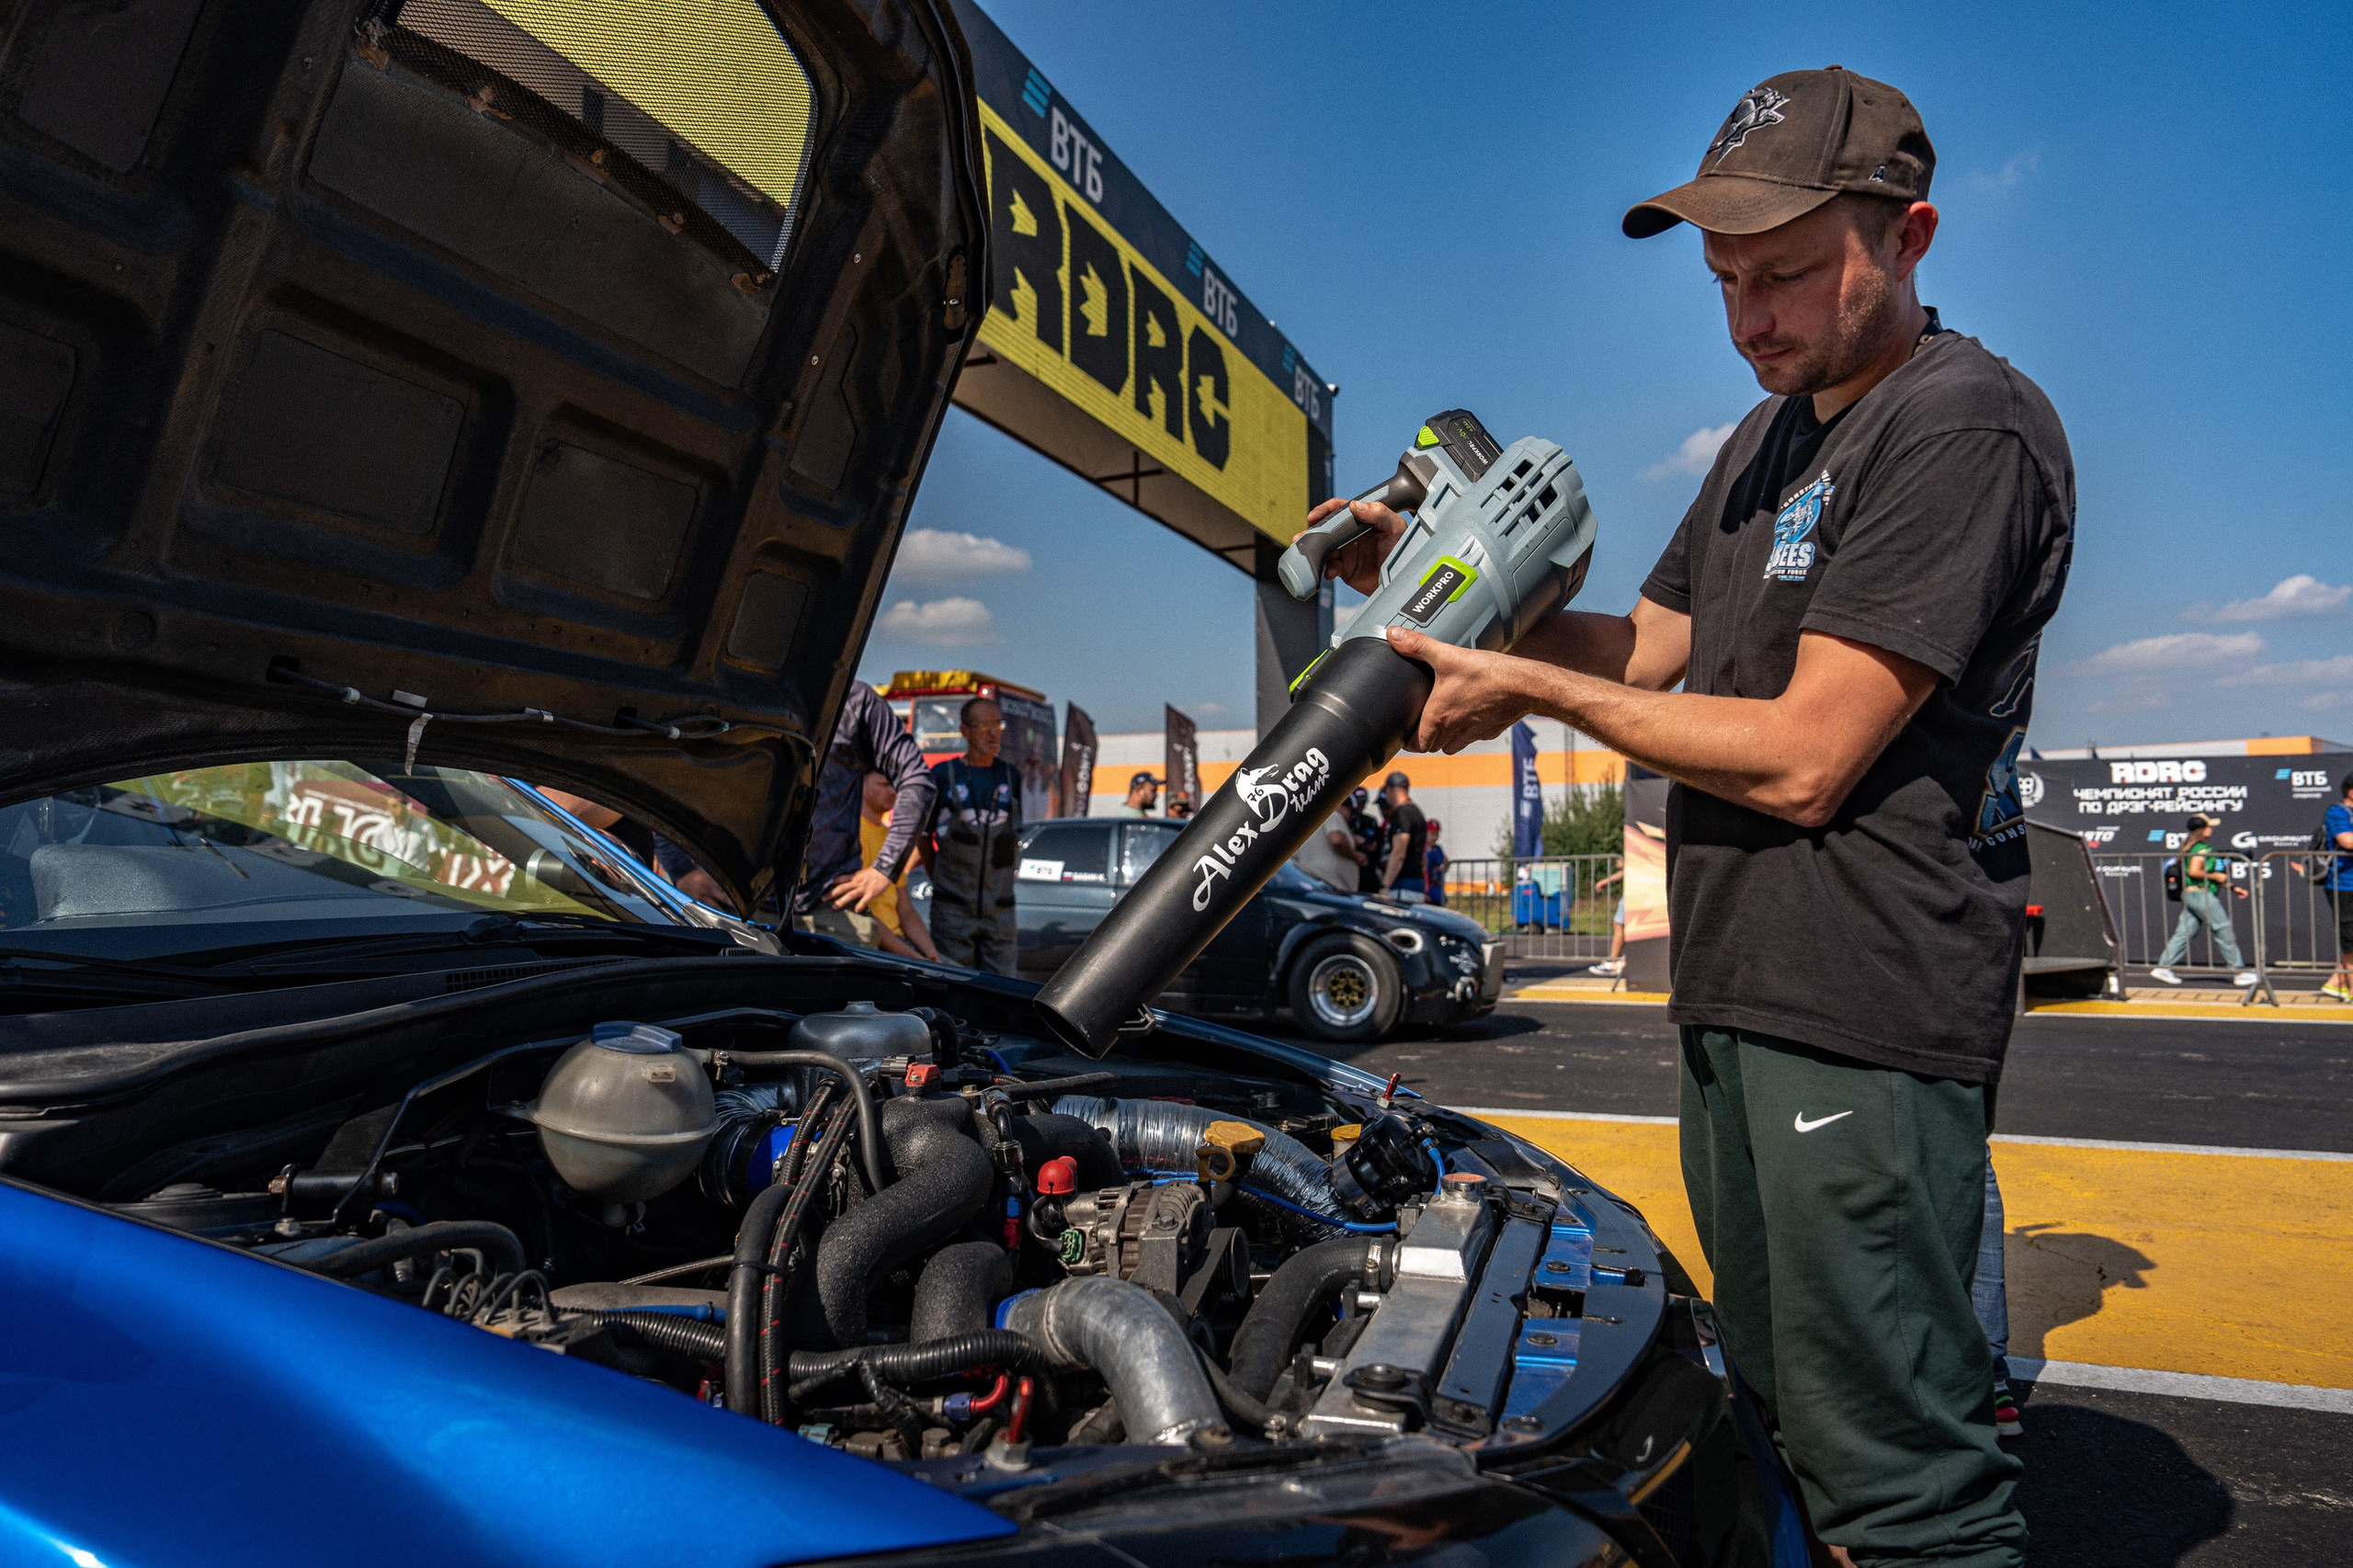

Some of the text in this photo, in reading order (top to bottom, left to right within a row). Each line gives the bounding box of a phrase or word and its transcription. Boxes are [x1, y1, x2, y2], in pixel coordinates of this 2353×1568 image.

[1050, 105, 1104, 204] ВТБ
[983, 124, 1231, 472] RDRC
[1203, 267, 1239, 338] ВТБ
[1294, 361, 1321, 421] ВТБ
[1412, 571, 1454, 614] WORKPRO
[2109, 760, 2207, 784] RDRC
[2291, 770, 2328, 787] ВТБ
[1247, 787, 1265, 802] 76
[1290, 773, 1330, 812] team
[2073, 786, 2248, 801] ЧЕМПИОНАТ РОССИИ
[2078, 798, 2244, 815] ПО ДРЭГ-РЕЙСИНГУ
[2165, 832, 2188, 849] ВТ
[1192, 820, 1258, 912] Alex
